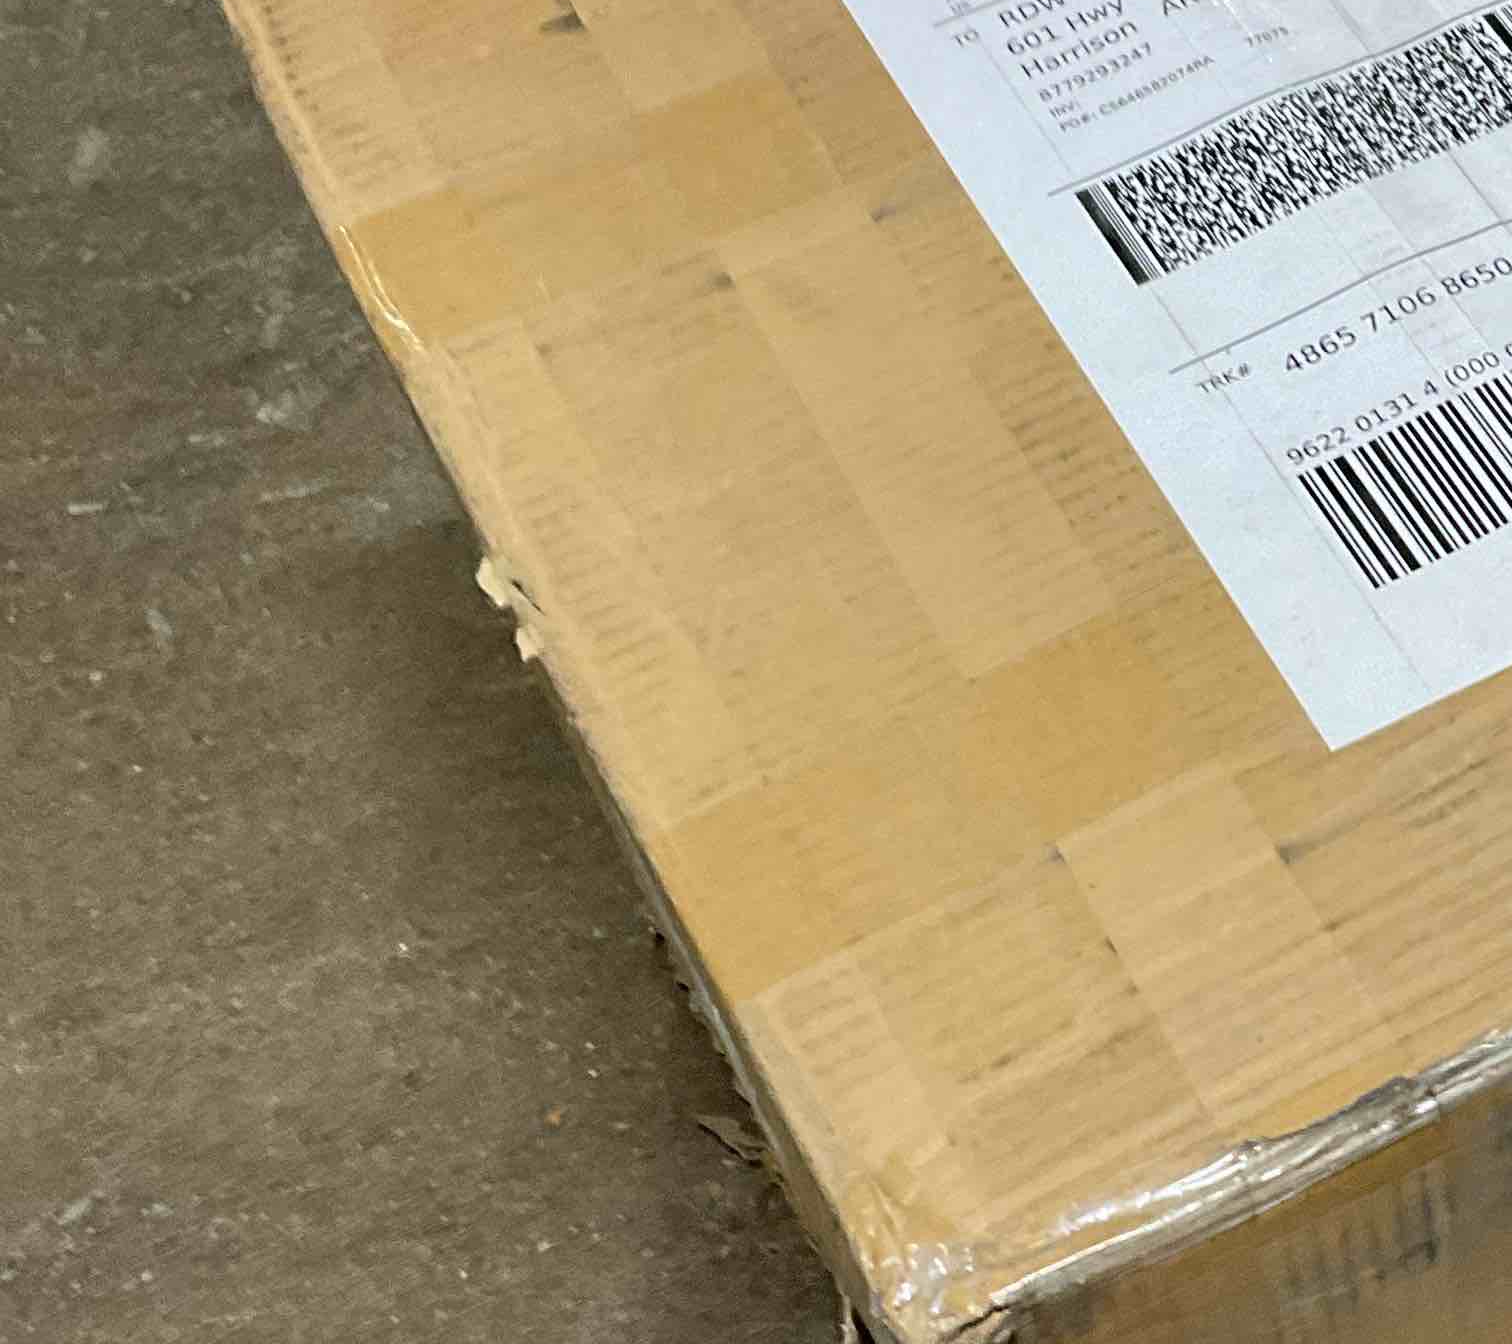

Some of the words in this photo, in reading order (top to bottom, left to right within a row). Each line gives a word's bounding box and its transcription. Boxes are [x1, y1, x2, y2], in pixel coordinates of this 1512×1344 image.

[1006, 25, 1059, 55] 601
[1019, 21, 1138, 81] Harrison
[1194, 362, 1250, 394] TRK#
[1285, 326, 1357, 372] 4865
[1359, 286, 1437, 333] 7106
[1439, 257, 1512, 296] 8650
[1286, 426, 1351, 466] 9622
[1354, 392, 1417, 433] 0131
[1423, 379, 1439, 396] 4
[1444, 351, 1500, 389] (000
